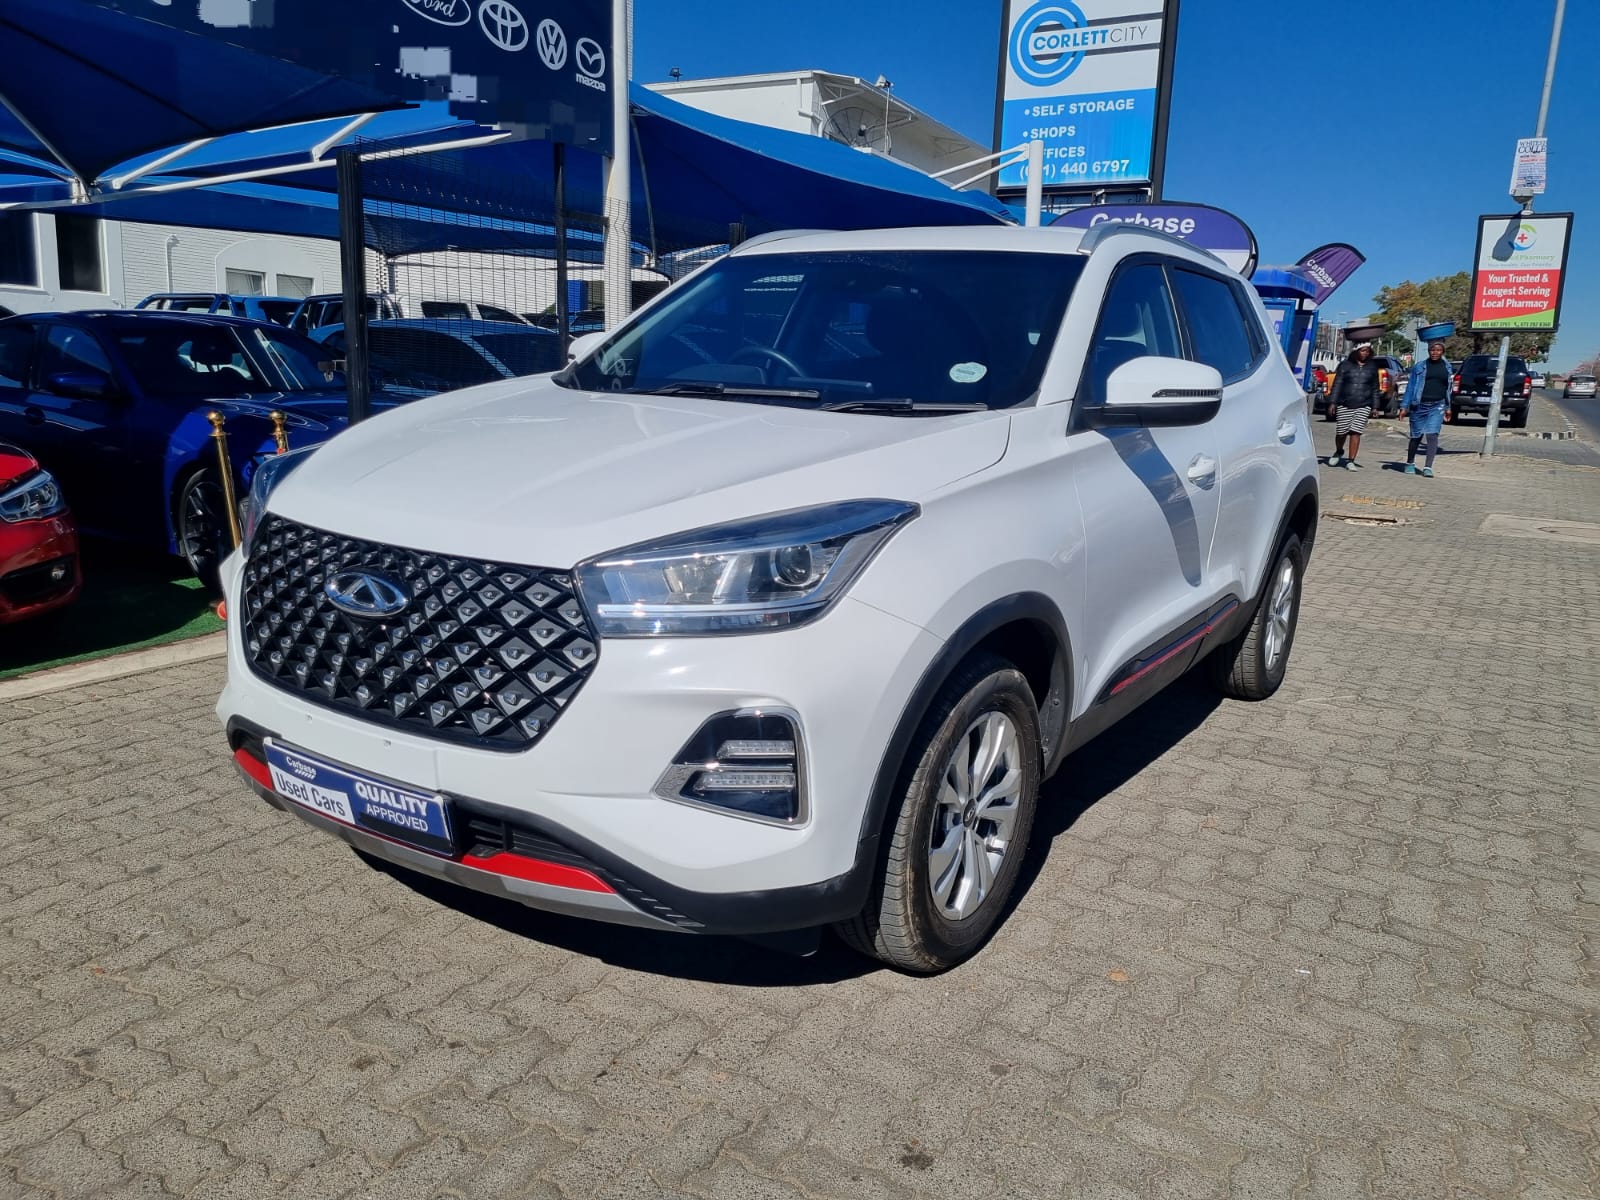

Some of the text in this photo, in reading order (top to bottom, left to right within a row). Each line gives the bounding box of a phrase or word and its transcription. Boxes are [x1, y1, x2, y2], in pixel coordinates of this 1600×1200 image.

[411, 0, 455, 17] ord
[576, 73, 606, 92] mazda
[1032, 98, 1135, 117] SELF STORAGE
[1030, 125, 1076, 139] SHOPS
[1043, 146, 1086, 159] FICES
[1060, 162, 1088, 175] 440
[1092, 159, 1130, 174] 6797
[1306, 259, 1337, 288] Carbase
[1488, 273, 1549, 283] Your Trusted &
[1482, 286, 1551, 298] Longest Serving
[1482, 298, 1549, 310] Local Pharmacy
[286, 756, 317, 776] Carbase
[275, 771, 346, 817] Used Cars
[355, 781, 428, 816] QUALITY
[366, 803, 429, 832] APPROVED
